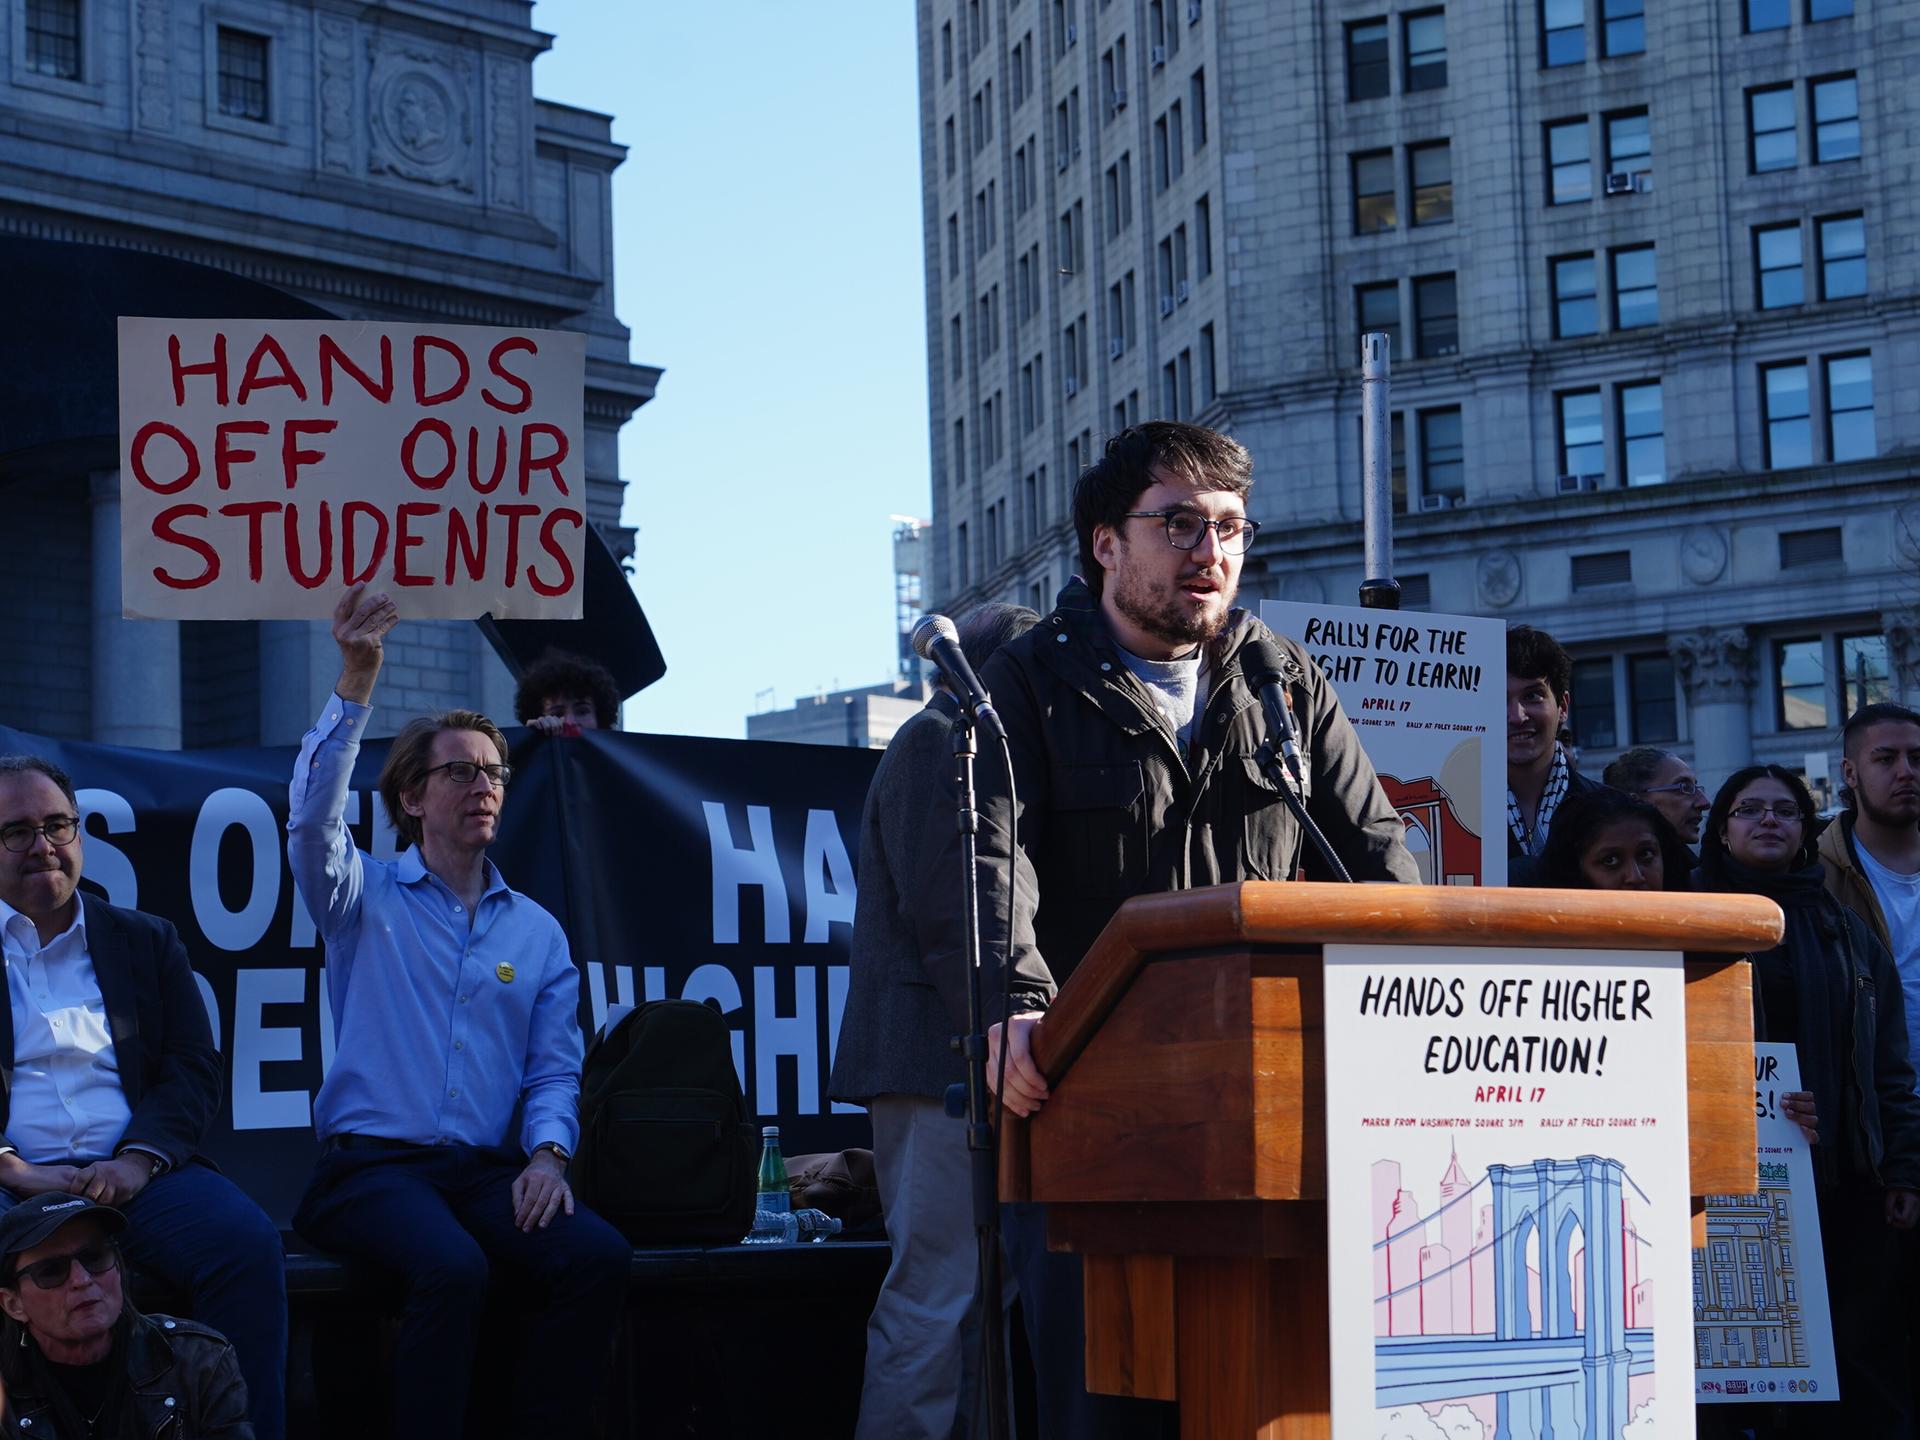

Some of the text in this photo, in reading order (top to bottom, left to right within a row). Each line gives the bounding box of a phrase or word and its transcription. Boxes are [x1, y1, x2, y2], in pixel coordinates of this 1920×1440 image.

[168, 333, 538, 414] HANDS
[131, 417, 569, 495] OFF OUR
[151, 500, 583, 598] STUDENTS
[1304, 617, 1468, 656] RALLY FOR THE
[1374, 657, 1399, 686] TO
[1405, 661, 1482, 693] LEARN!
[1361, 697, 1411, 713] APRIL 17
[1361, 718, 1382, 727] SQUARE
[1405, 720, 1424, 729] RALLY
[1434, 722, 1450, 731] FOLEY
[1452, 723, 1473, 732] SQUARE
[1359, 975, 1654, 1022] HANDS OFF HIGHER
[1423, 1034, 1608, 1077] EDUCATION!
[1755, 1055, 1780, 1082] UR
[1474, 1084, 1547, 1105] APRIL 17
[1361, 1117, 1391, 1128] MARCH
[1394, 1117, 1417, 1128] FROM
[1420, 1117, 1471, 1128] WASHINGTON
[1475, 1118, 1504, 1128] SQUARE
[1540, 1118, 1563, 1128] RALLY
[1567, 1117, 1578, 1127] AT
[1581, 1117, 1605, 1127] FOLEY
[1608, 1117, 1637, 1127] SQUARE
